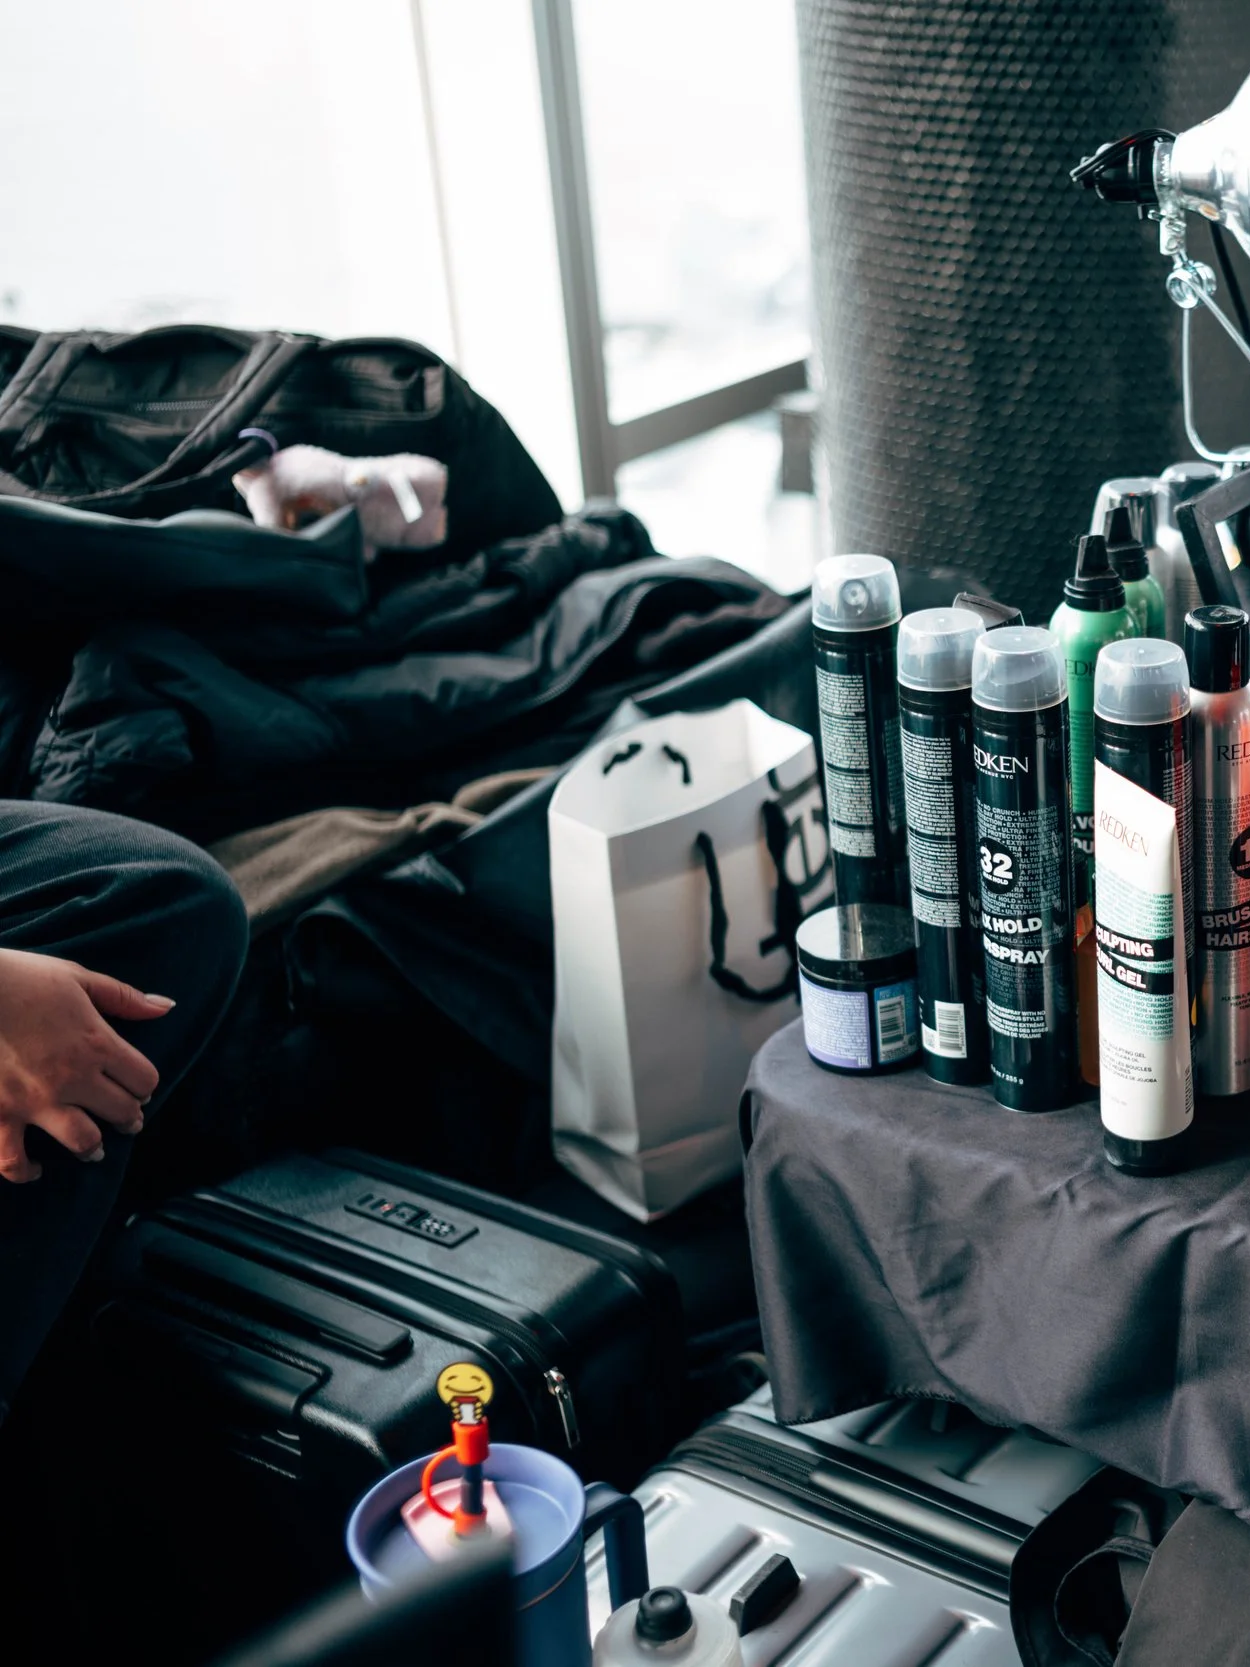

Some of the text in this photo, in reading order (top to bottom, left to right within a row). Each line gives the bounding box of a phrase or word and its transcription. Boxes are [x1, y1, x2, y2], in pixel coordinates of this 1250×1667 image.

[973, 743, 1029, 774] EDKEN
[992, 807, 1020, 816] CRUNCH
[1099, 810, 1150, 857] REDKEN
[980, 845, 1014, 880] 32
[992, 917, 1043, 935] HOLD
[1116, 965, 1147, 989] GEL
